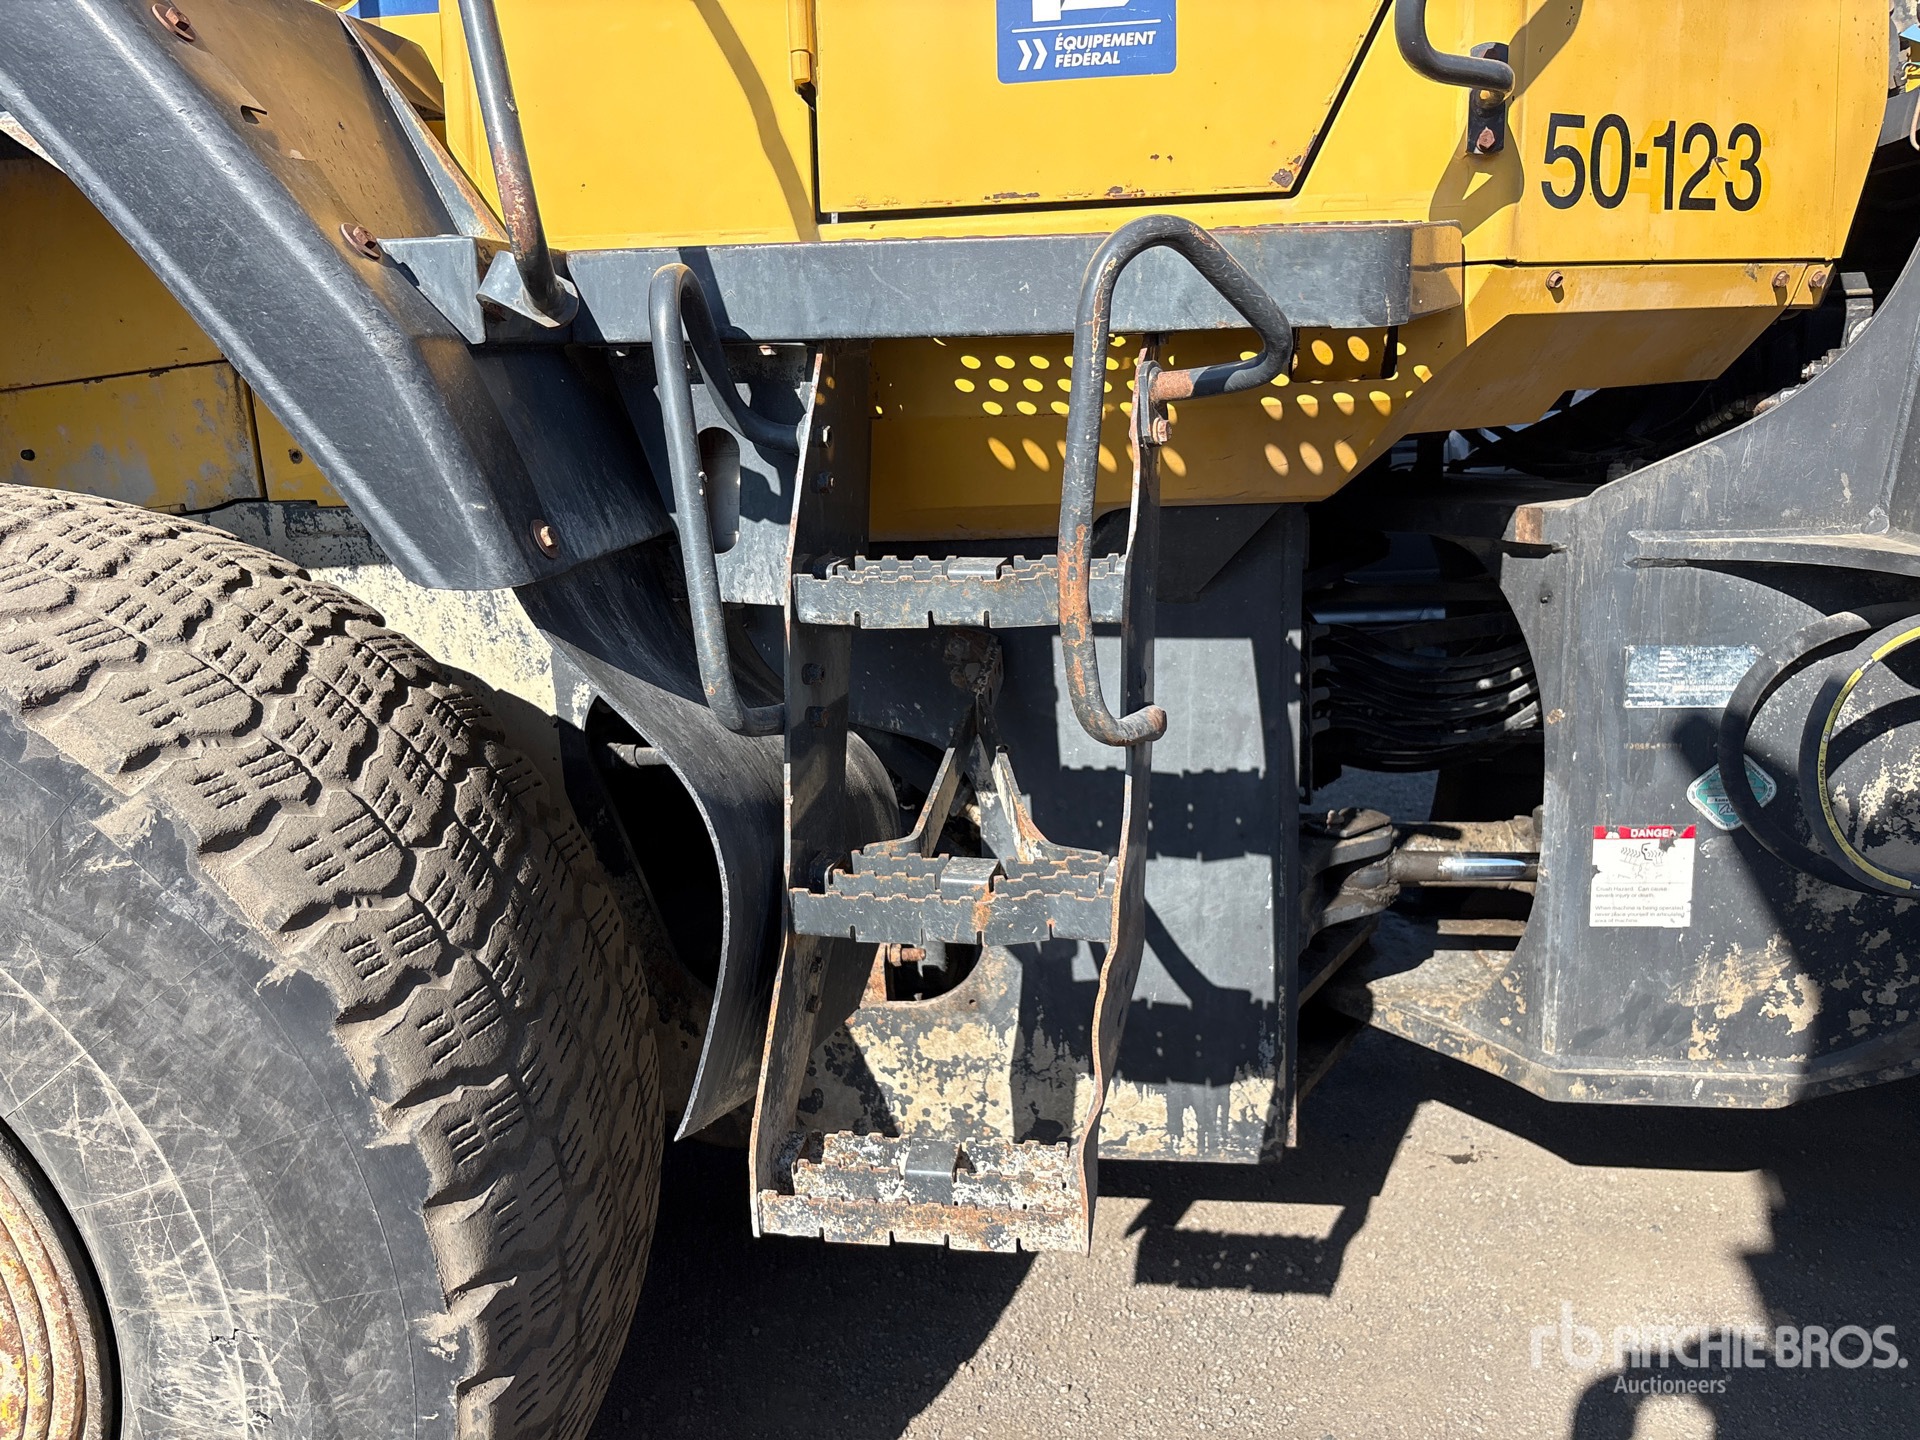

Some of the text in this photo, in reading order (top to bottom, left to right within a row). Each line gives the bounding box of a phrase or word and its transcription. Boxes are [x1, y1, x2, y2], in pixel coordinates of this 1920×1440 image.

[1055, 31, 1156, 51] ÉQUIPEMENT
[1055, 51, 1120, 68] FÉDÉRAL
[1541, 112, 1762, 212] 50-123
